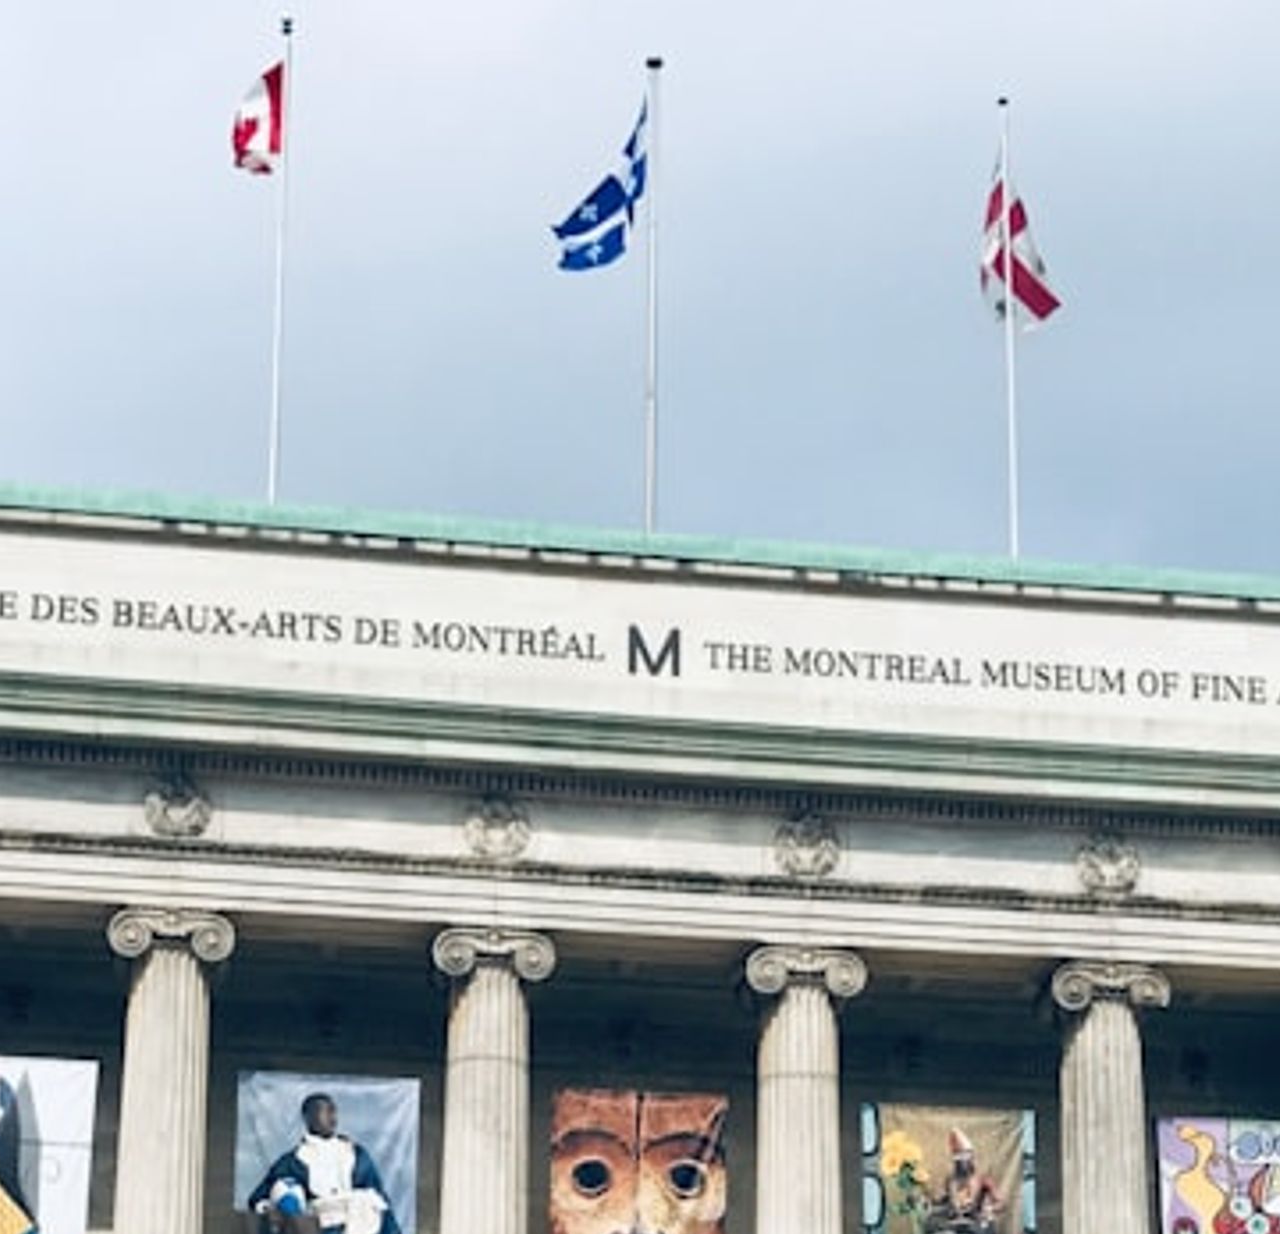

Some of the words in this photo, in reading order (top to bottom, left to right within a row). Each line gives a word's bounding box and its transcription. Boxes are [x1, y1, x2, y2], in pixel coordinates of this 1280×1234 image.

[30, 593, 100, 625] DES
[112, 599, 343, 642] BEAUX-ARTS
[354, 618, 400, 647] DE
[412, 621, 606, 662] MONTRÉAL
[627, 623, 681, 677] M
[703, 641, 772, 673] THE
[784, 646, 971, 686] MONTREAL
[980, 659, 1125, 695] MUSEUM
[1137, 668, 1180, 698] OF
[1190, 672, 1268, 705] FINE
